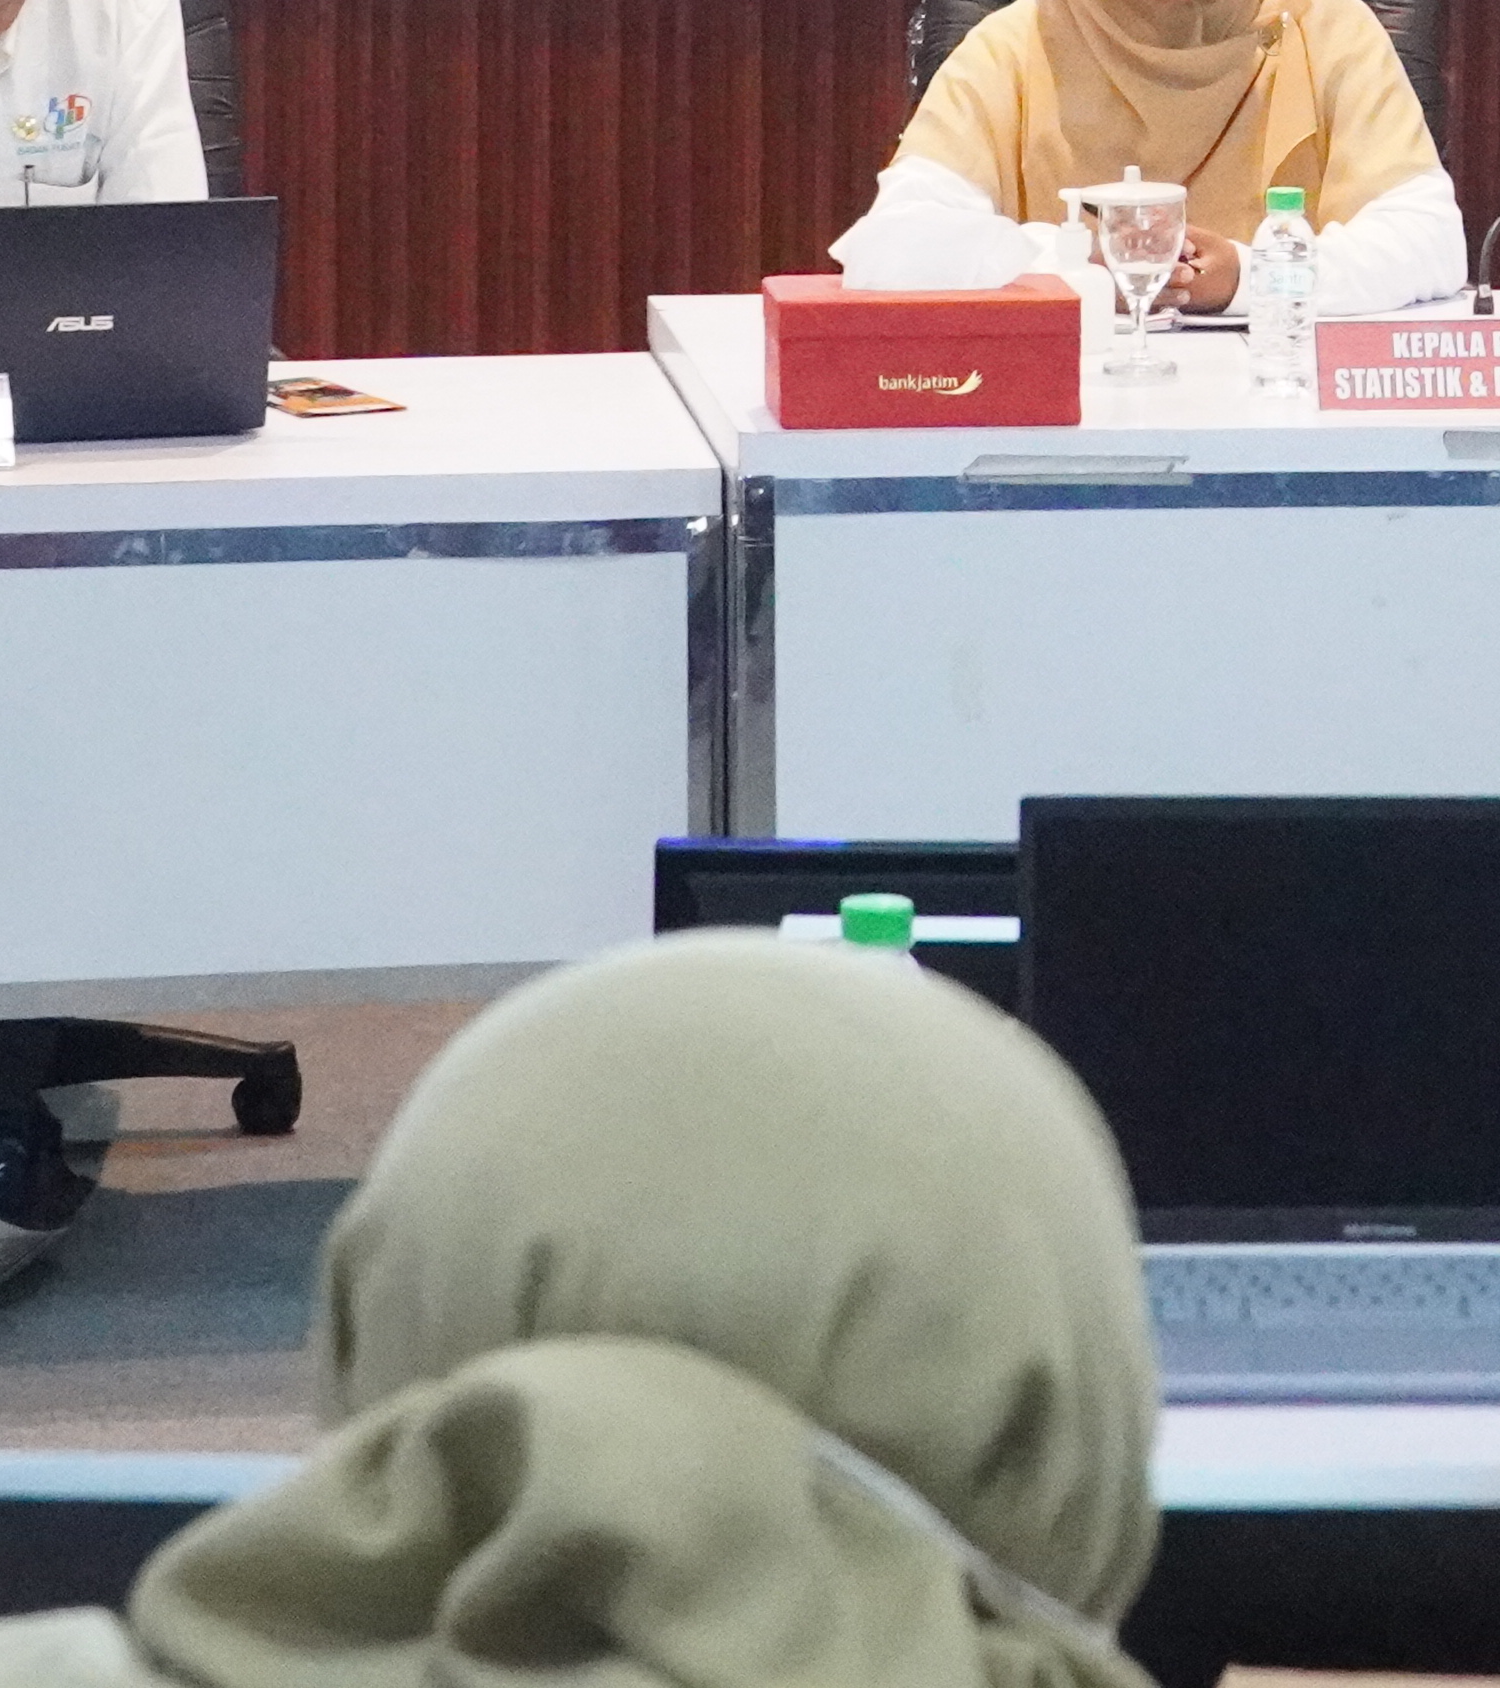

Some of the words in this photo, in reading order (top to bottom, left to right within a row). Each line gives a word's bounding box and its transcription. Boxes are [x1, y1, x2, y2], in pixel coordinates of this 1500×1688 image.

[45, 314, 114, 332] ASUS
[1391, 330, 1487, 359] KEPALA
[878, 373, 960, 392] bankjatim
[1334, 367, 1463, 400] STATISTIK
[1469, 370, 1488, 399] &
